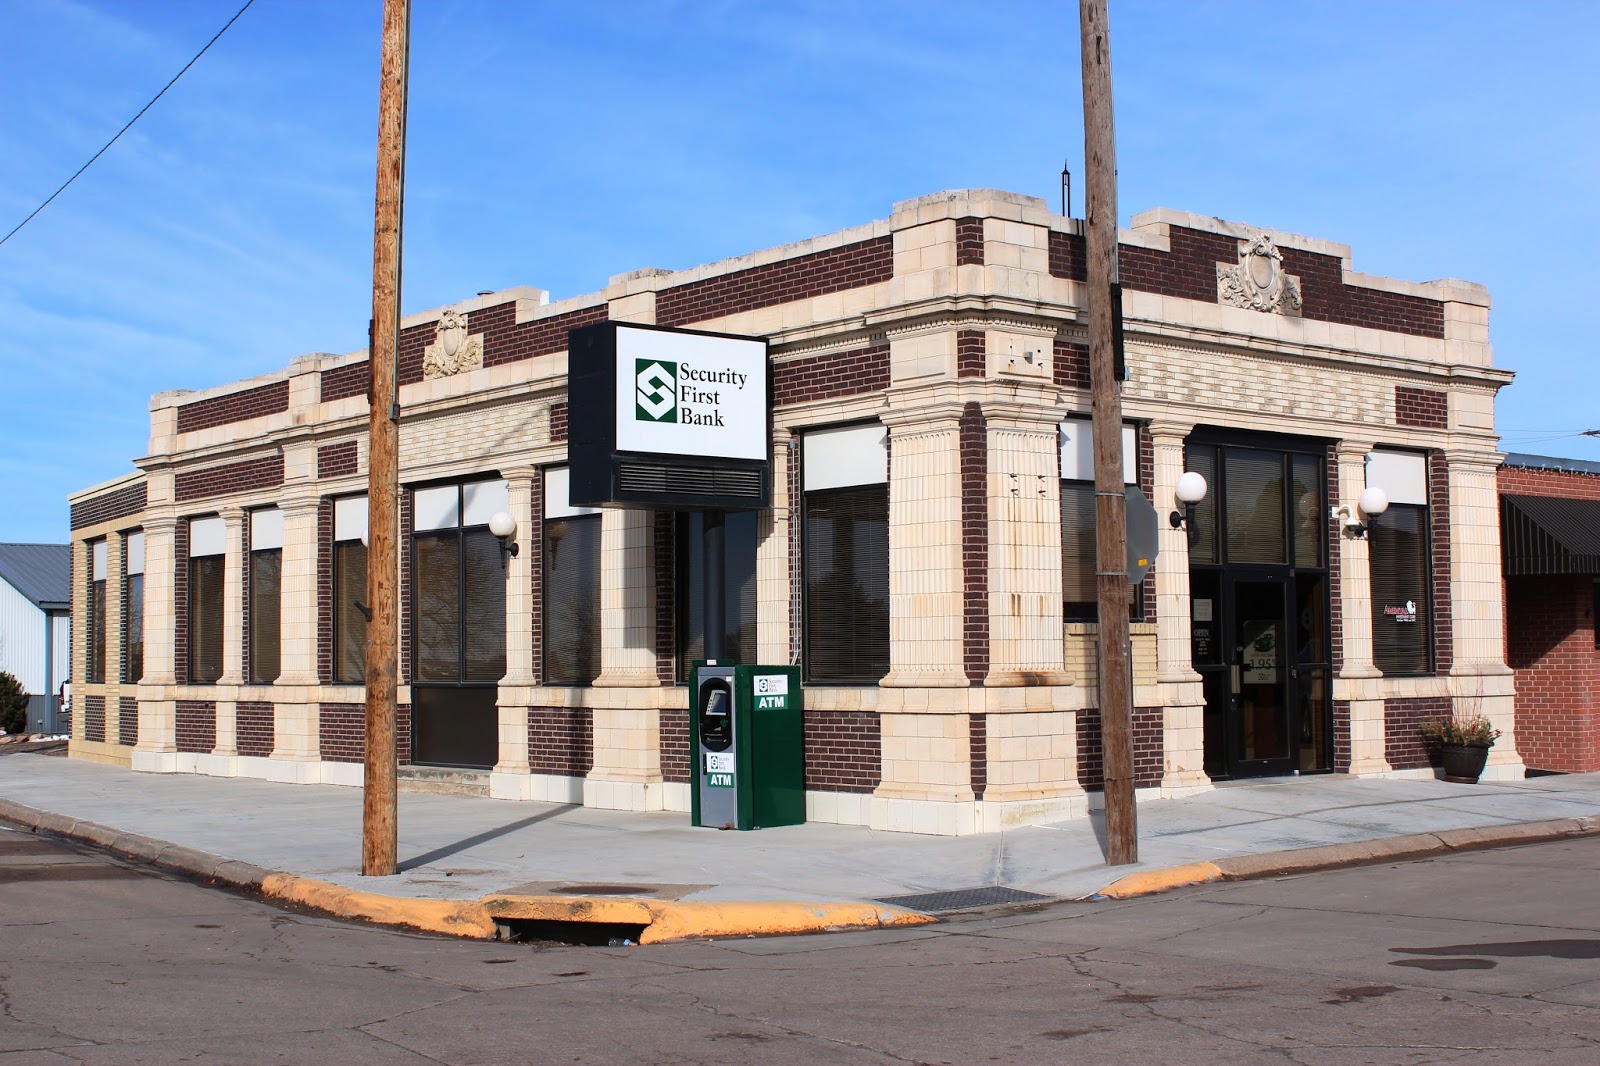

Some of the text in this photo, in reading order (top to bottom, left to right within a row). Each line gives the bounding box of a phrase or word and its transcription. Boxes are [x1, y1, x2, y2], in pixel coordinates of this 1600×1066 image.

[680, 362, 748, 390] Security
[680, 385, 720, 405] First
[681, 407, 725, 427] Bank
[758, 696, 784, 708] ATM
[711, 774, 731, 785] ATM
